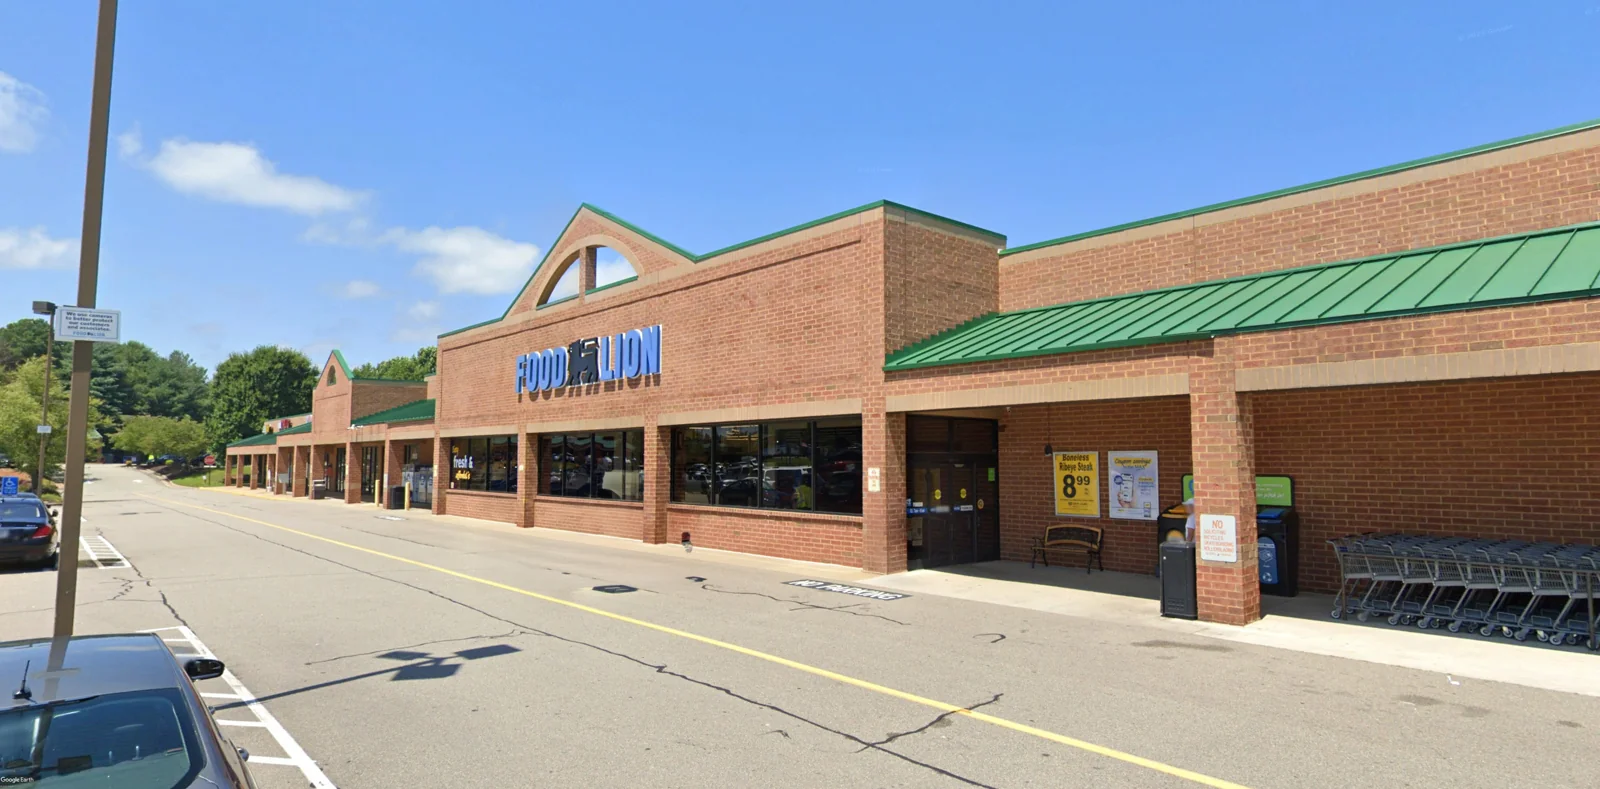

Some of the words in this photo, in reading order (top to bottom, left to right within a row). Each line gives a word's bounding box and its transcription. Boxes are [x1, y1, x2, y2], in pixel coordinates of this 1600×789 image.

[515, 346, 568, 394] FOOD
[600, 324, 662, 381] LION
[453, 455, 468, 468] fresh
[469, 456, 473, 468] &
[1059, 462, 1076, 473] Ribeye
[1078, 461, 1093, 471] Steak
[1063, 474, 1076, 498] 8
[1076, 475, 1090, 485] 99
[1212, 520, 1223, 529] NO
[816, 585, 903, 600] PARKING
